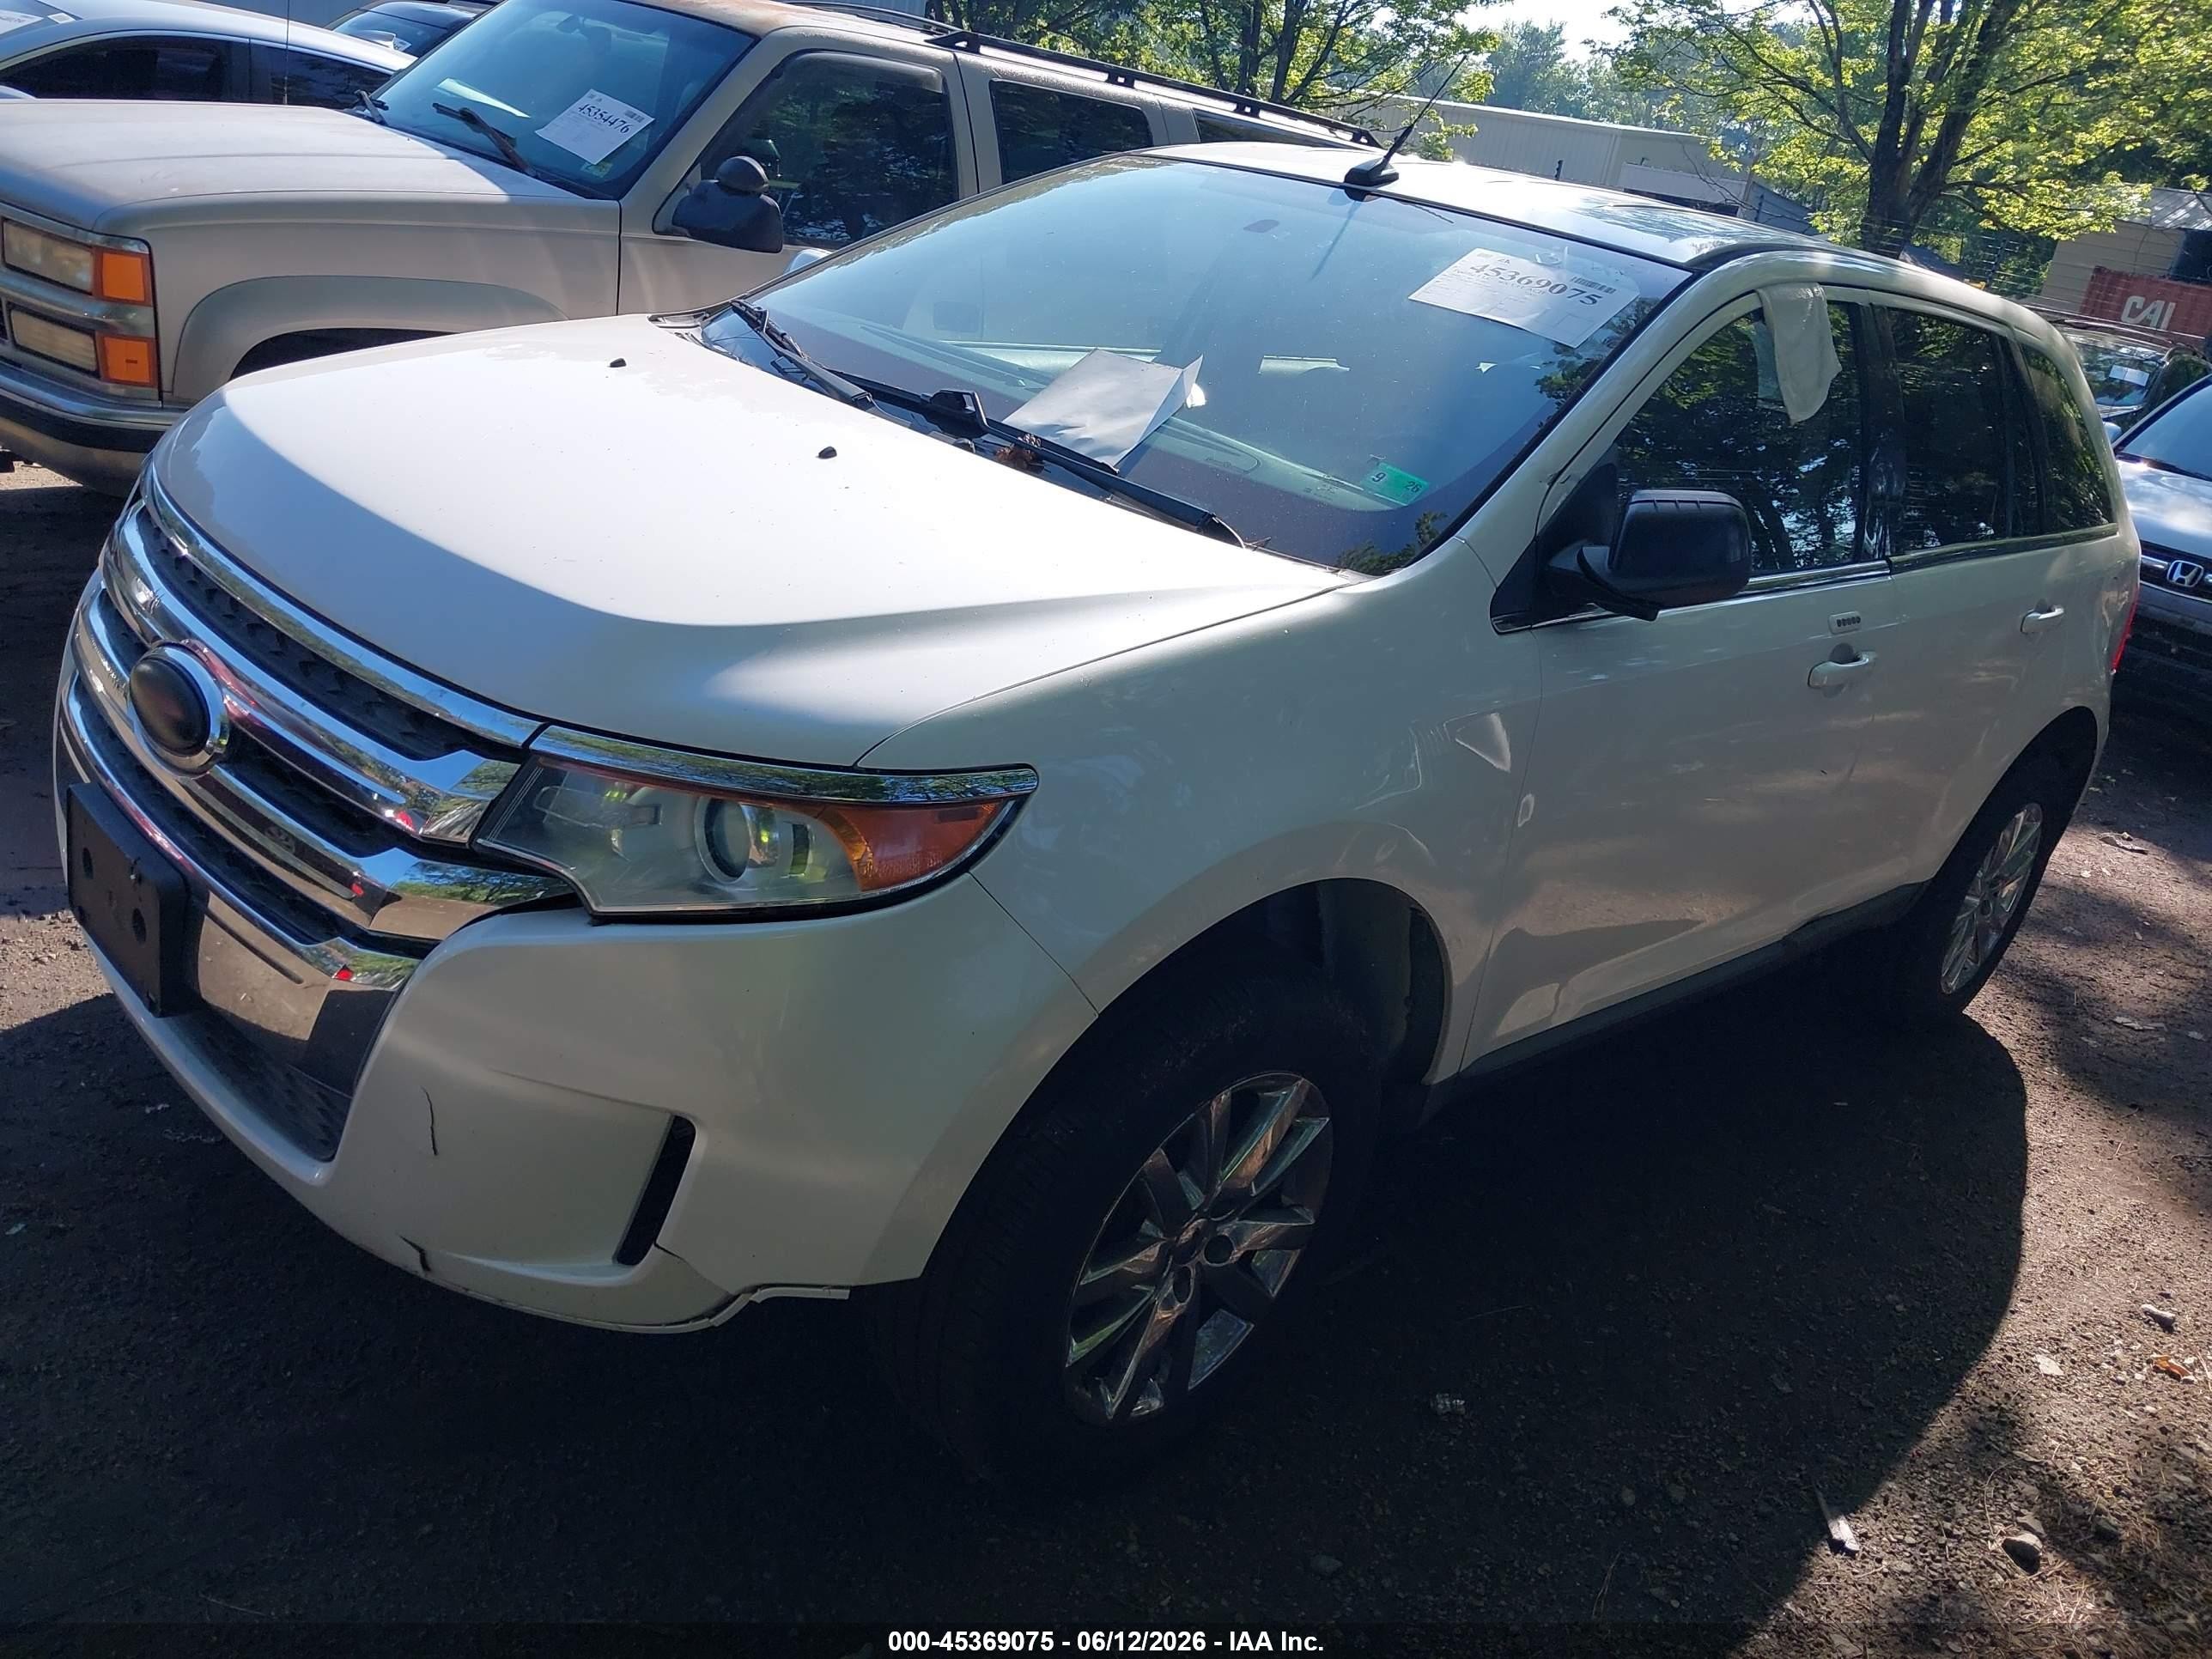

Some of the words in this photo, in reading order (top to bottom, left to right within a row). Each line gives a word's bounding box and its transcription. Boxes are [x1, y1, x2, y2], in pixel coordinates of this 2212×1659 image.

[578, 104, 634, 134] 45354476
[1469, 263, 1603, 306] 45369075
[2120, 295, 2177, 331] CAI
[1371, 471, 1387, 483] 9
